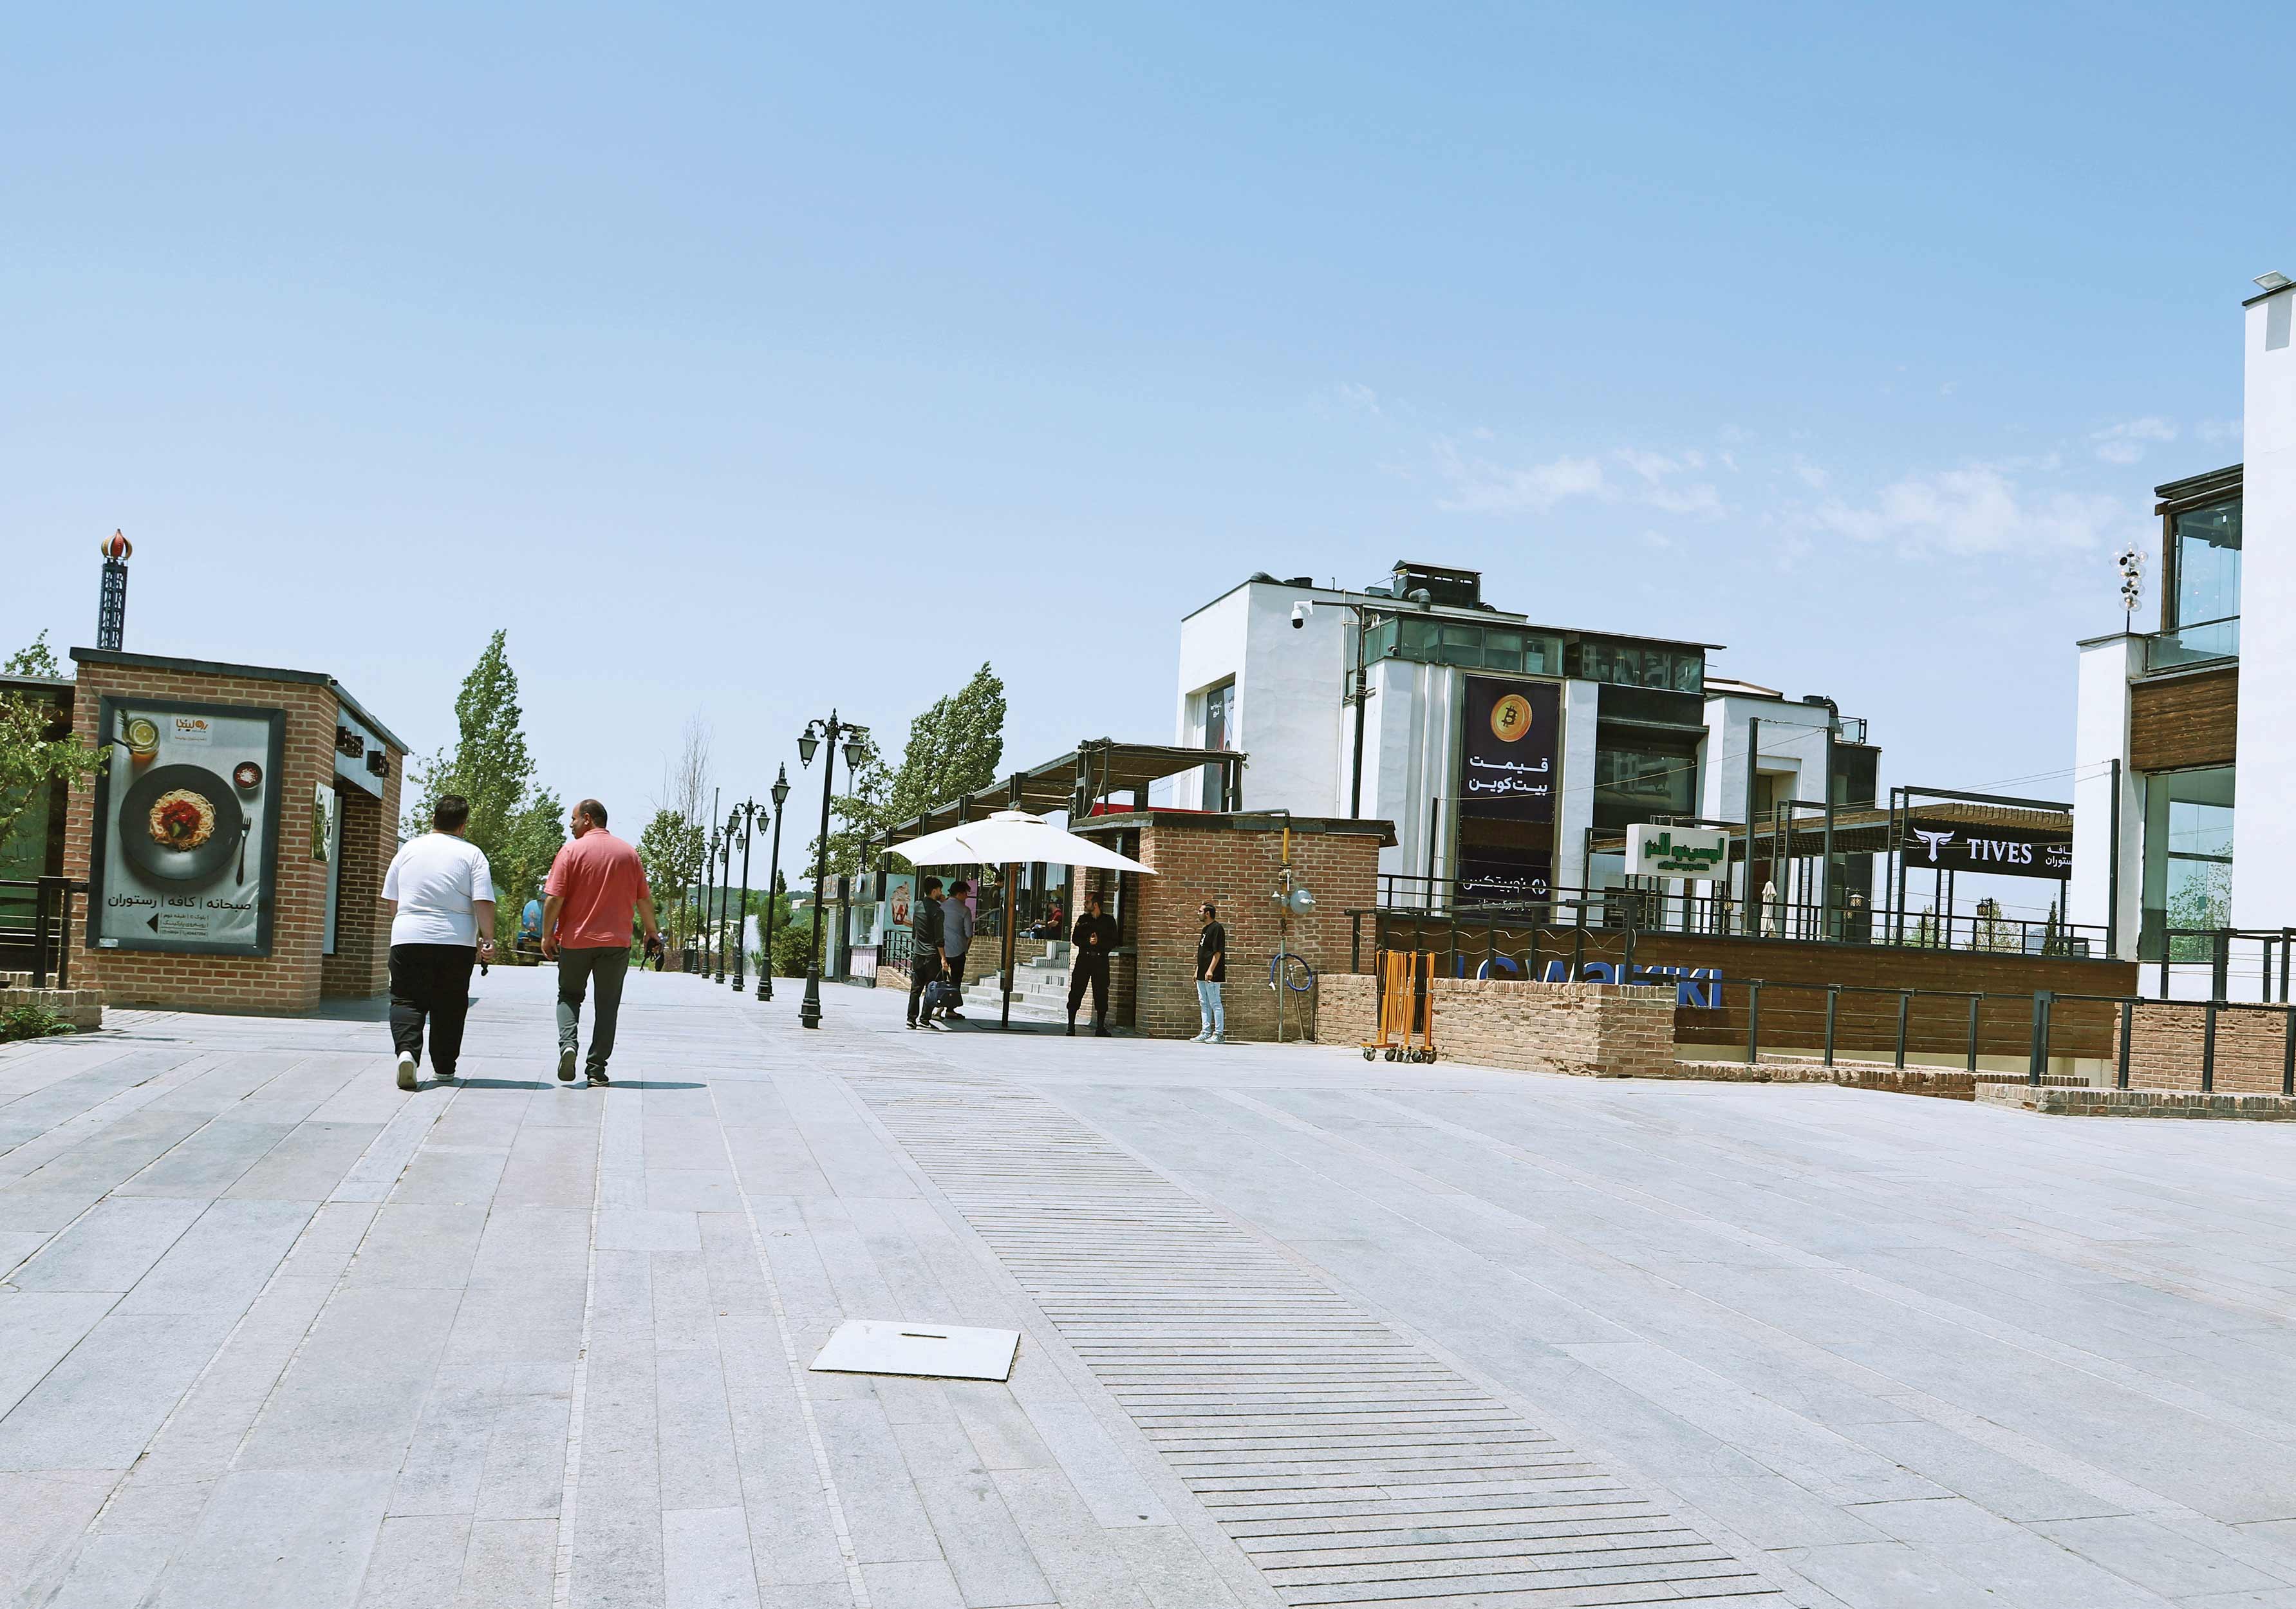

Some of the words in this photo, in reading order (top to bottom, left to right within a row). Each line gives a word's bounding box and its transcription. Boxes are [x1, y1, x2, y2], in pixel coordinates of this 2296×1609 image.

[1470, 756, 1549, 774] قیمت
[1967, 838, 2032, 864] TIVES
[2047, 845, 2072, 854] افه
[2045, 855, 2072, 868] ستوران
[108, 894, 157, 908] رستوران
[168, 896, 196, 907] کافه
[207, 898, 252, 912] صبحانه
